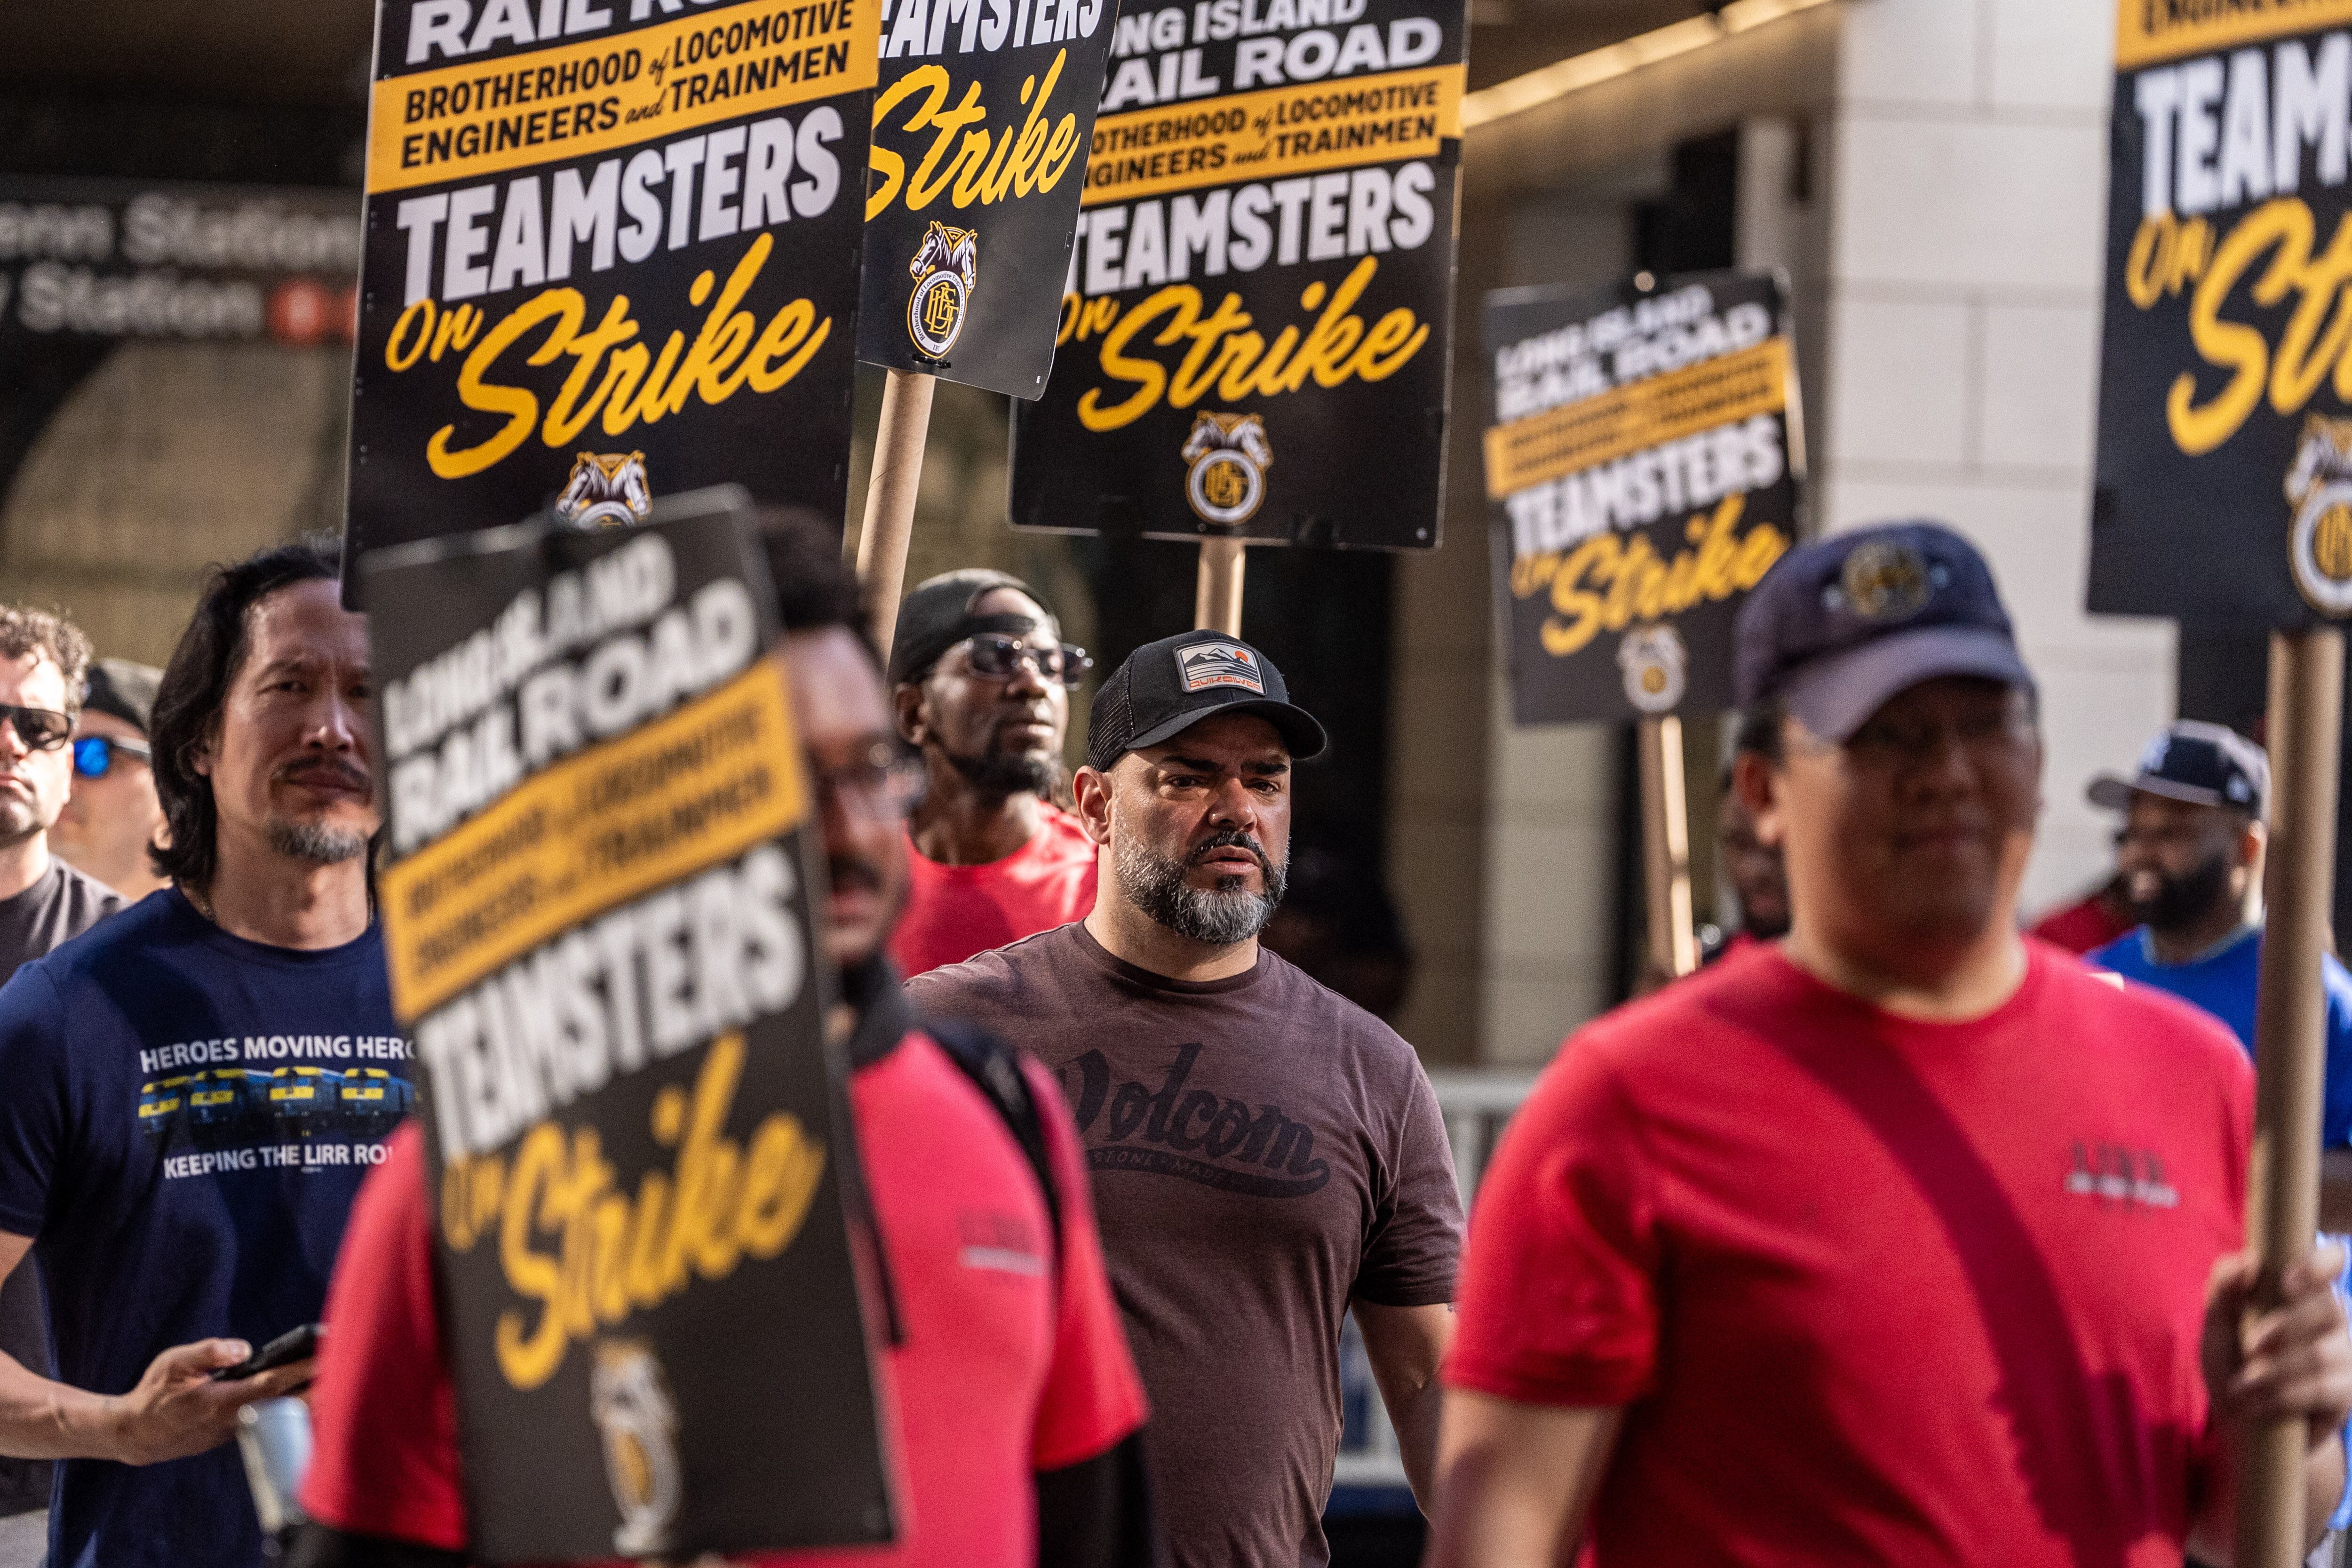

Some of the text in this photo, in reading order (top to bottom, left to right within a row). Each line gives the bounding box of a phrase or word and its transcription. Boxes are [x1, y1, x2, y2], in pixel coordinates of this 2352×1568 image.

[404, 0, 853, 124] BROTHERHOOD of LOCOMOTIVE
[405, 0, 612, 65] RAIL
[1100, 17, 1443, 113] AIL ROAD
[401, 41, 850, 168] ENGINEERS and TRAINMEN
[865, 48, 1081, 222] Strike
[1091, 107, 1247, 156] OTHERHOOD
[1276, 80, 1440, 126] LOCOMOTIVE
[1275, 116, 1437, 159] TRAINMEN
[2134, 30, 2352, 222] TEAM
[397, 106, 844, 307] TEAMSTERS
[385, 297, 484, 373] On
[923, 272, 952, 289] Locomotive
[1077, 255, 1431, 432] Strike
[426, 232, 832, 479] Strike
[1505, 413, 1784, 562] TEAMSTERS
[1540, 490, 1790, 657] Strike
[518, 577, 755, 767] ROAD
[1189, 675, 1261, 691] QUIKSILVER
[139, 1038, 239, 1073] HEROES
[243, 1035, 352, 1060] MOVING
[416, 842, 805, 1164] TEAMSTERS
[163, 1147, 257, 1179] KEEPING
[258, 1145, 301, 1166] THE
[304, 1144, 350, 1165] LIRR
[1054, 1042, 1315, 1176] Volcom
[494, 1028, 828, 1391] Strike
